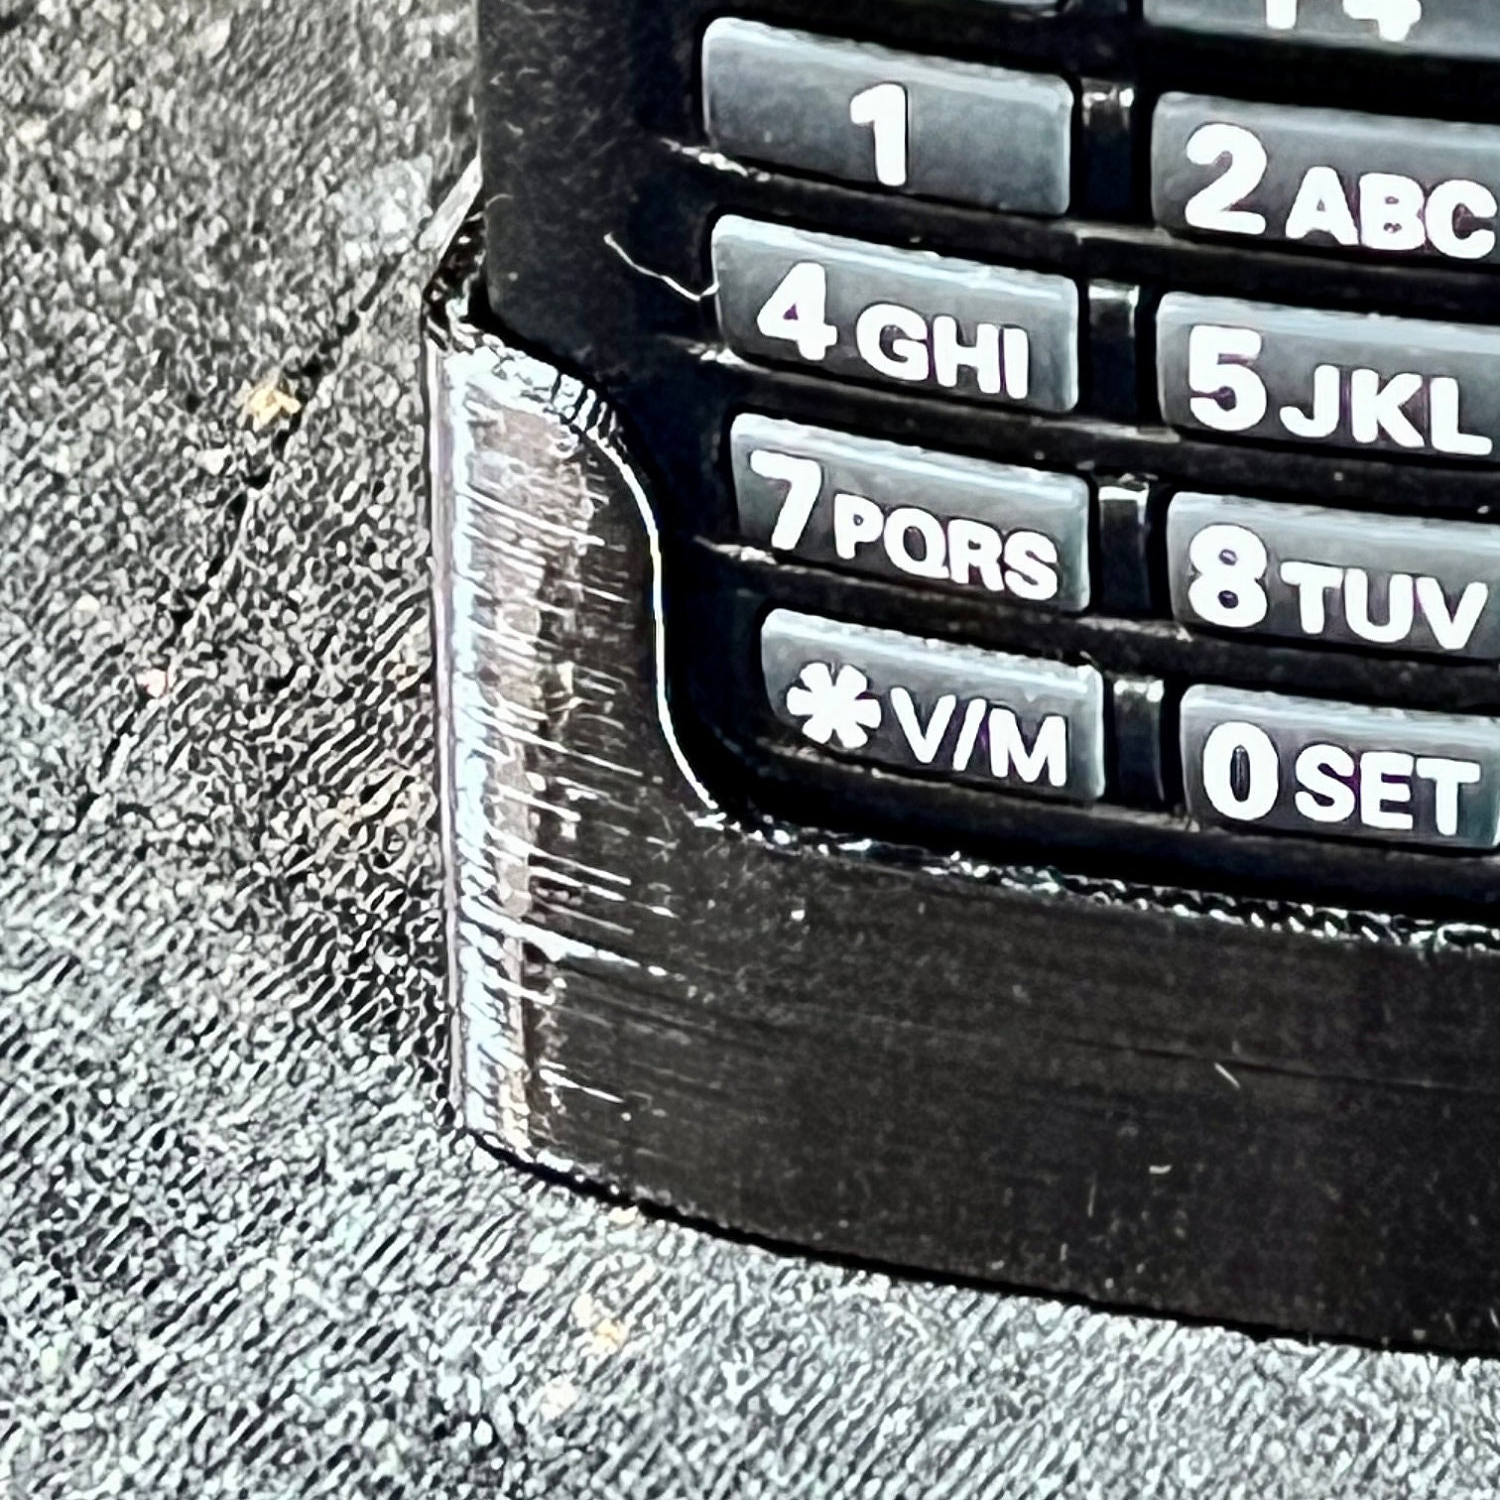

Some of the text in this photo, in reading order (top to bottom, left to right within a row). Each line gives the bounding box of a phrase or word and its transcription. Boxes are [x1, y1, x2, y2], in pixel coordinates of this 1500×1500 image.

[849, 82, 907, 187] 1
[1184, 122, 1499, 260] 2 ABC
[756, 261, 1032, 396] 4 GHI
[1187, 323, 1493, 456] 5 JKL
[749, 448, 1059, 601] 7 PQRS
[1187, 523, 1490, 651] 8 TUV
[889, 686, 1068, 788] V/M
[1202, 720, 1482, 837] 0 SET
